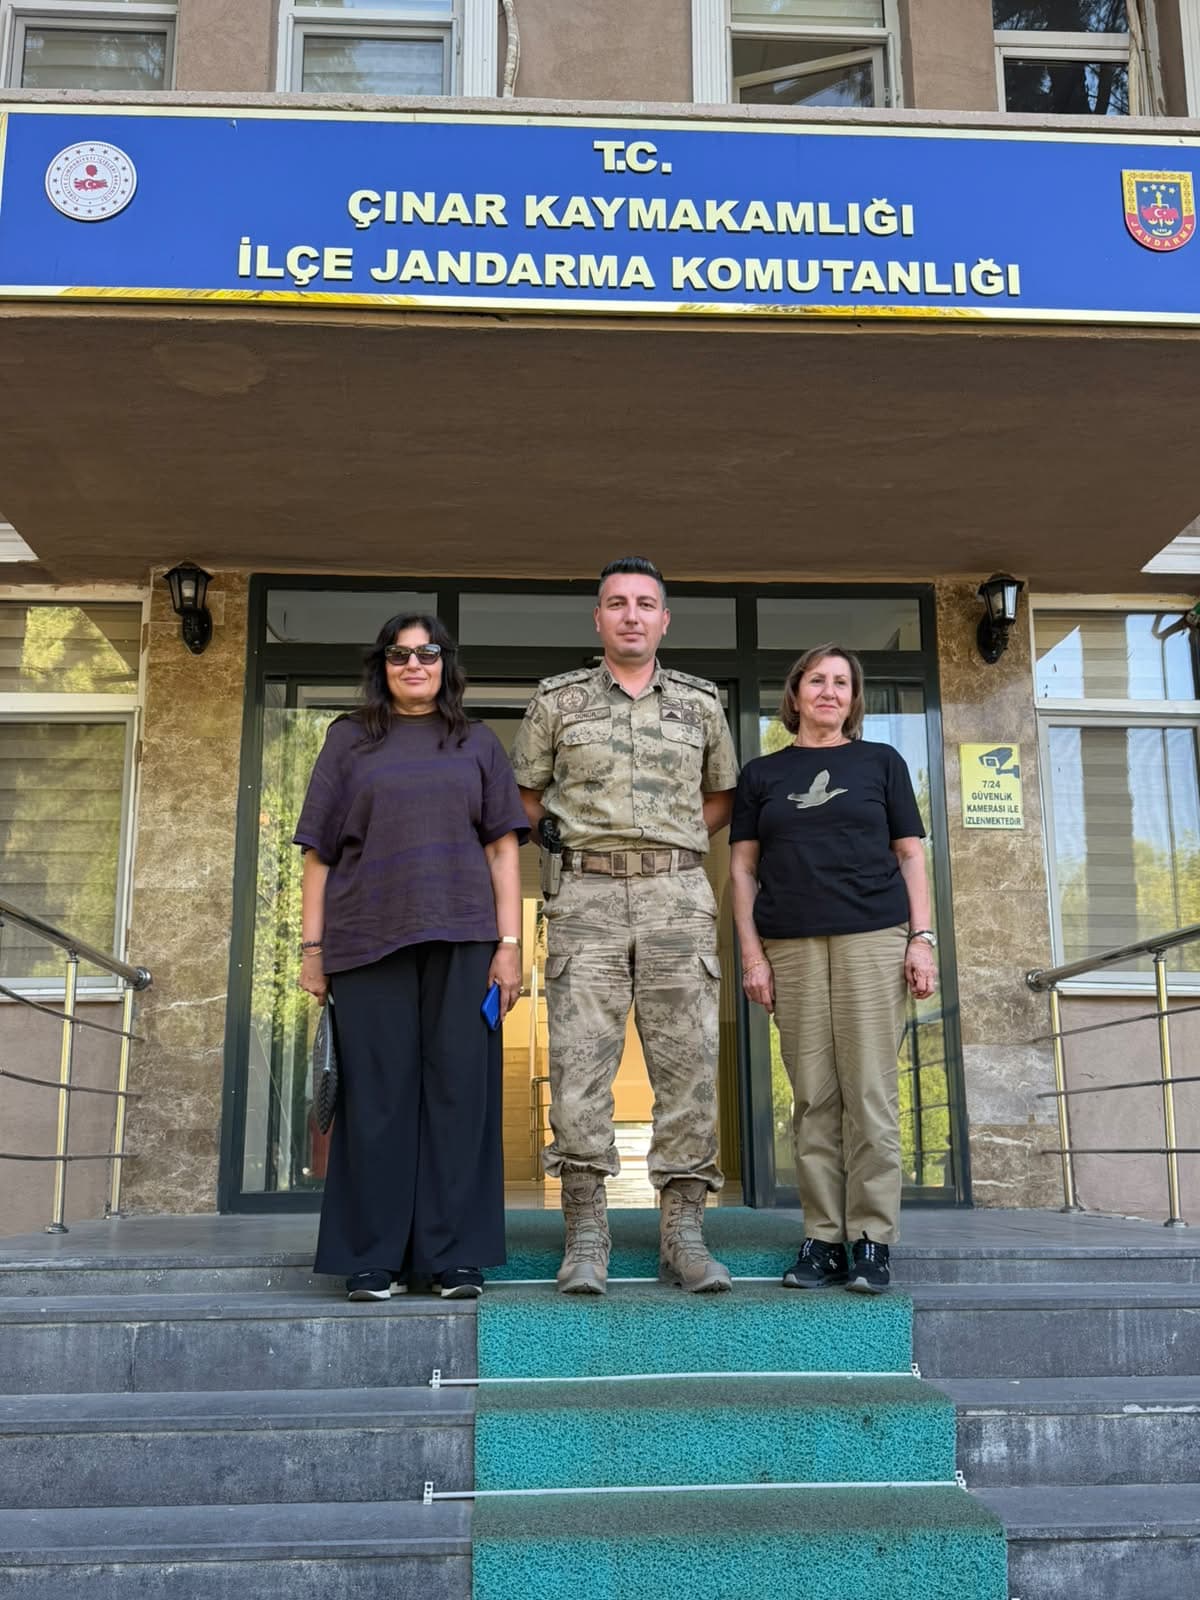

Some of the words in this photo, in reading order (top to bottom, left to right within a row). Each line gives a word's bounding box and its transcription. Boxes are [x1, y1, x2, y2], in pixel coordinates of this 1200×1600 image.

[593, 140, 672, 172] T.C.
[348, 189, 509, 228] ÇINAR
[525, 195, 914, 235] KAYMAKAMLIĞI
[1130, 221, 1193, 247] JANDARMA
[238, 236, 353, 285] İLÇE
[370, 249, 656, 289] JANDARMA
[672, 256, 1021, 296] KOMUTANLIĞI
[981, 780, 1001, 788] 7/24
[971, 791, 1013, 801] GÜVENLİK
[966, 804, 1006, 813] KAMERASI
[965, 816, 1021, 826] İZLENMEKTEDİR
